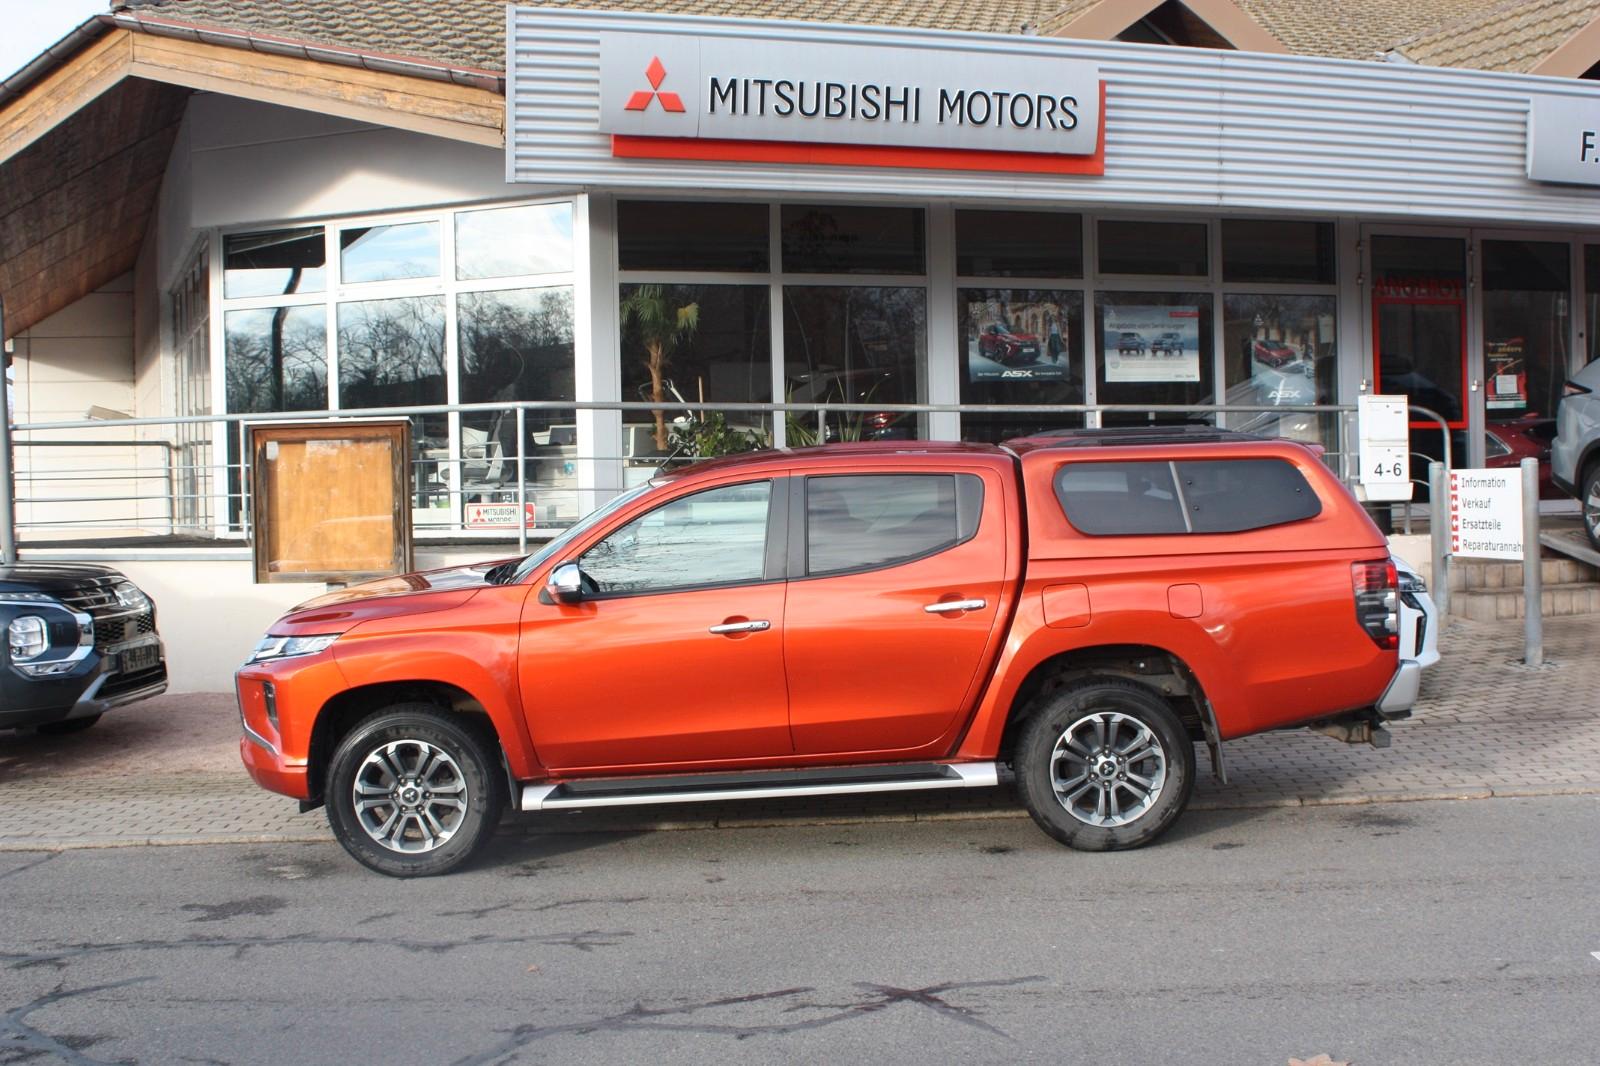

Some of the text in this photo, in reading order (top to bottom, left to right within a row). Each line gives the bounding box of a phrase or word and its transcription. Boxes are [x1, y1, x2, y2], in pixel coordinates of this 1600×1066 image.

[708, 76, 1079, 131] MITSUBISHI MOTORS
[1580, 130, 1600, 164] F.
[1001, 370, 1033, 378] ASX
[1461, 477, 1506, 489] Information
[1462, 498, 1491, 509] Verkauf
[483, 508, 516, 516] MITSUBISHI
[1462, 518, 1502, 531] Ersatzteile
[1463, 539, 1524, 553] Reparaturannah
